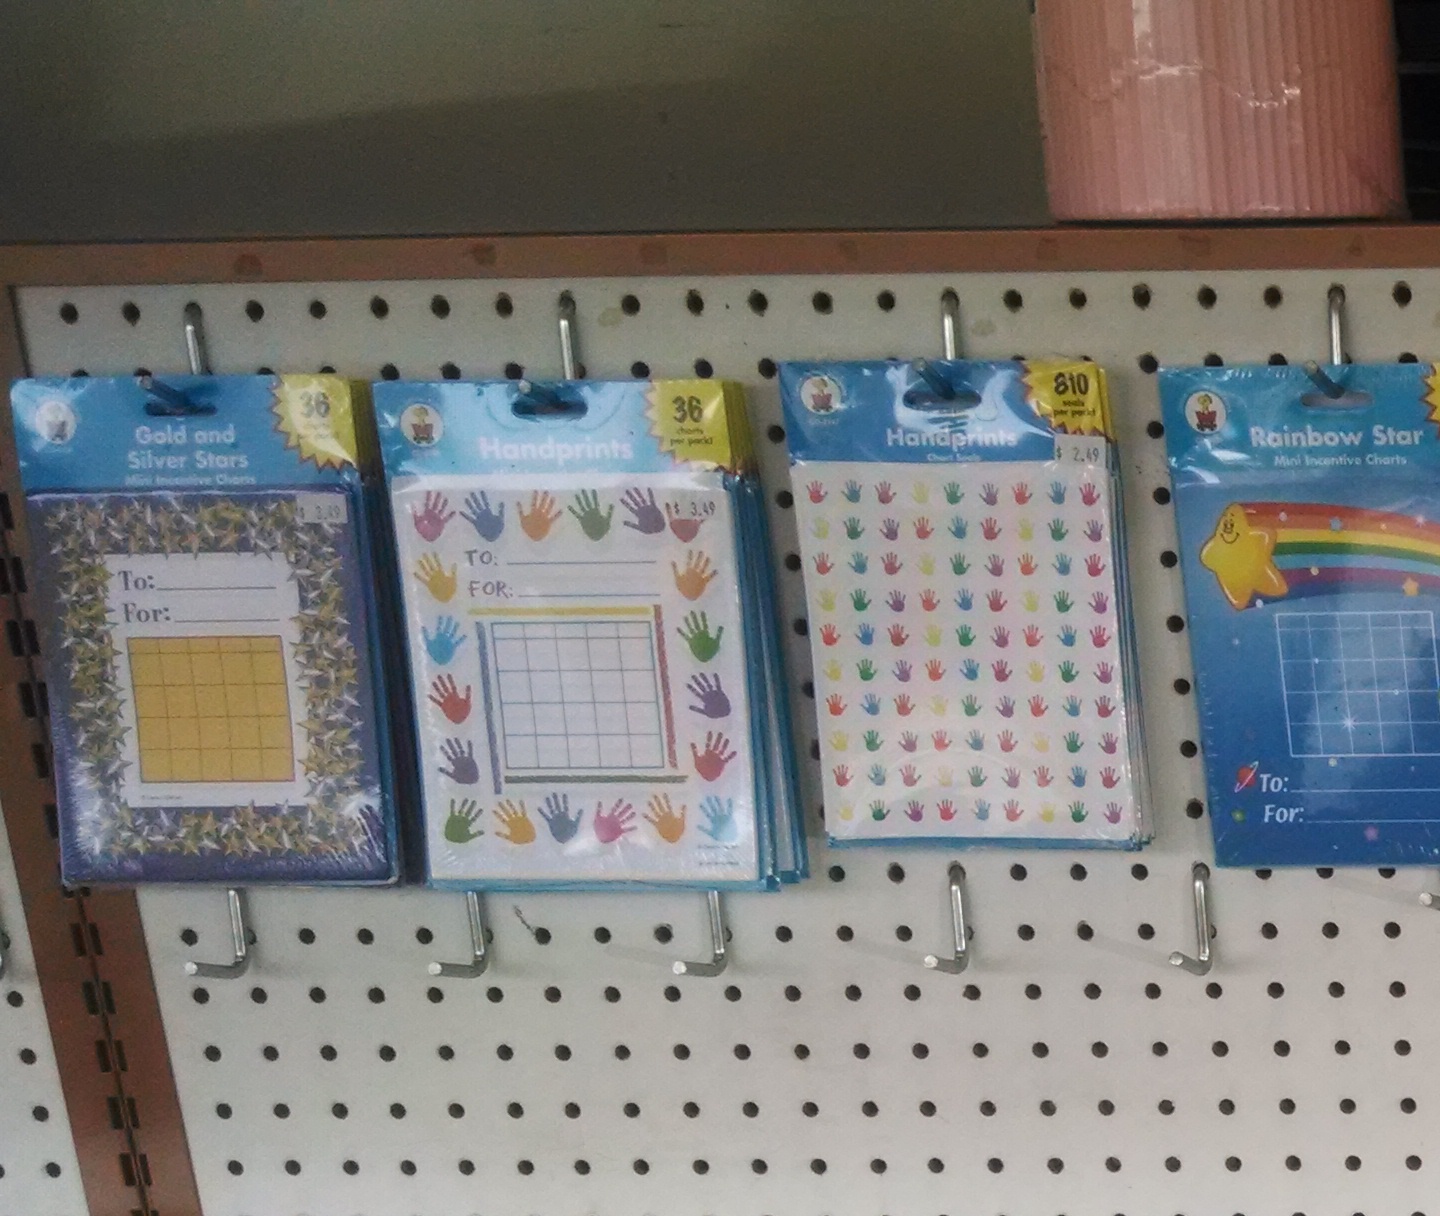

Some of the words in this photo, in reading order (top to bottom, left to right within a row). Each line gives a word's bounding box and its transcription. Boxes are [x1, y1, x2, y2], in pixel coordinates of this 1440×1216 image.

[1053, 371, 1090, 396] 810
[671, 395, 704, 424] 36
[135, 423, 188, 445] Gold
[194, 422, 236, 445] and
[886, 427, 1019, 453] Handprints
[1249, 423, 1364, 449] Rainbow
[1372, 424, 1425, 447] Star
[127, 449, 187, 469] Silver
[195, 449, 249, 469] Stars
[480, 434, 635, 467] Handprints
[1073, 447, 1100, 463] 2.49
[1272, 454, 1302, 467] Mini
[1304, 454, 1363, 466] Incentive
[1364, 453, 1409, 466] Charts
[465, 549, 499, 567] TO:
[118, 569, 156, 592] To:
[468, 580, 514, 599] FOR:
[122, 603, 171, 626] For:
[1258, 773, 1290, 794] To:
[1263, 804, 1305, 824] For:
